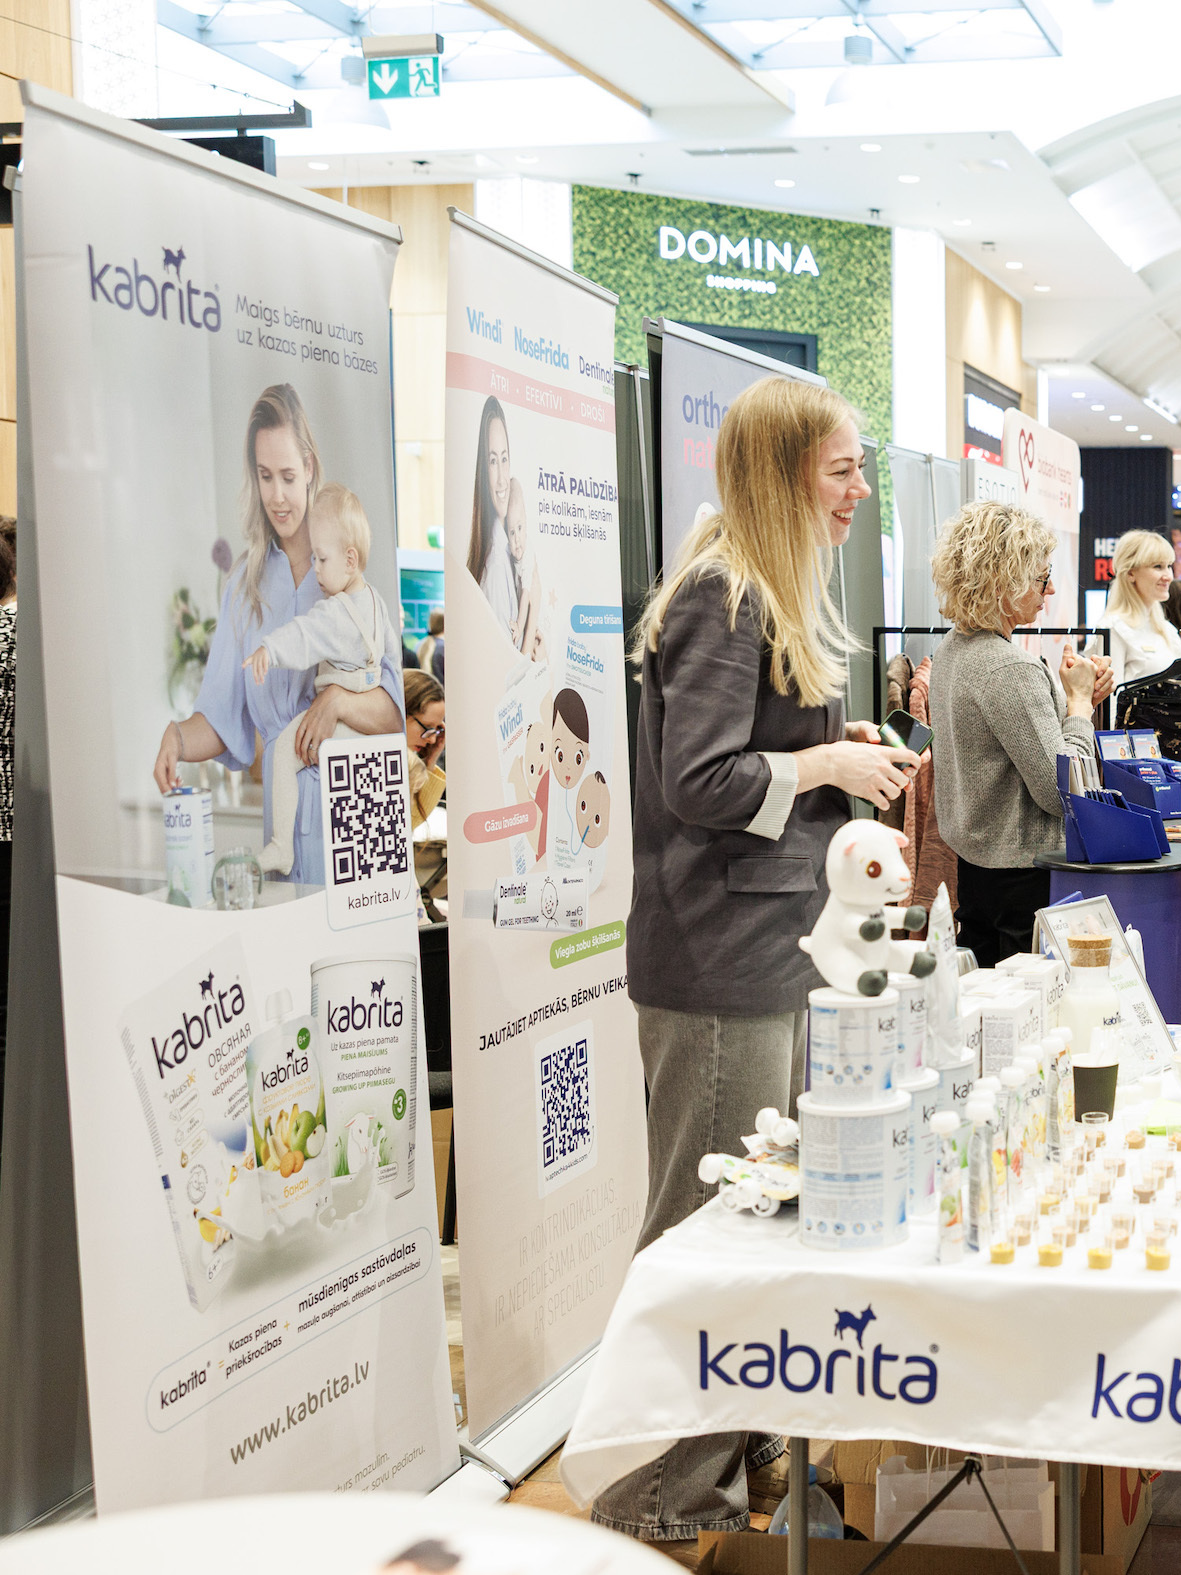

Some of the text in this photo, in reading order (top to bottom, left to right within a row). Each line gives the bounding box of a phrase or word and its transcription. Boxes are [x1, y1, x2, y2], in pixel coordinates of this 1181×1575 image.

[659, 225, 820, 277] DOMINA
[87, 244, 222, 333] kabrita
[235, 295, 364, 346] Maigs bērnu uzturs
[466, 306, 503, 344] Windi
[514, 326, 570, 370] NoseFrida
[236, 328, 379, 375] uz kazas piena bāzes
[490, 371, 605, 425] ĀTRI EFEKTĪVI DROŠI
[683, 435, 716, 470] nat
[537, 467, 567, 494] ĀTRĀ
[538, 501, 613, 523] pie kolikām, iesnām
[539, 523, 607, 542] un zobu šķilšanās
[1094, 538, 1119, 557] HE
[579, 613, 604, 627] Deguna
[566, 645, 604, 673] NoseFrida
[500, 703, 524, 741] Windi
[484, 818, 502, 833] Gāzu
[348, 888, 401, 910] kabrita.lv
[555, 946, 575, 959] Viegla
[575, 939, 591, 953] zobu
[151, 983, 246, 1079] kabrita
[327, 994, 403, 1035] kabrita
[479, 975, 628, 1051] JAUTĀJIET APTIEKĀS, BĒRNU VEIKA
[208, 1022, 252, 1068] ОВСЯНАЯ
[330, 1036, 399, 1051] Uz kazas piena pamata
[341, 1053, 357, 1061] PIENA
[261, 1056, 309, 1092] kabrita
[332, 1085, 357, 1094] GROWING
[283, 1177, 309, 1198] банан
[519, 1236, 527, 1268] IR
[298, 1241, 416, 1313] mūsdienīgas sastāvdaļas
[377, 1278, 386, 1287] un
[495, 1294, 505, 1328] IR
[508, 1244, 576, 1317] NEPIECIEŠAMA
[228, 1318, 277, 1353] Kazas piena
[225, 1336, 282, 1379] priekšrocības
[699, 1329, 939, 1404] kabrita
[160, 1367, 208, 1409] kabrita
[230, 1360, 370, 1465] www.kabrita.lv
[371, 1470, 390, 1491] savu
[391, 1445, 426, 1479] pediatru.
